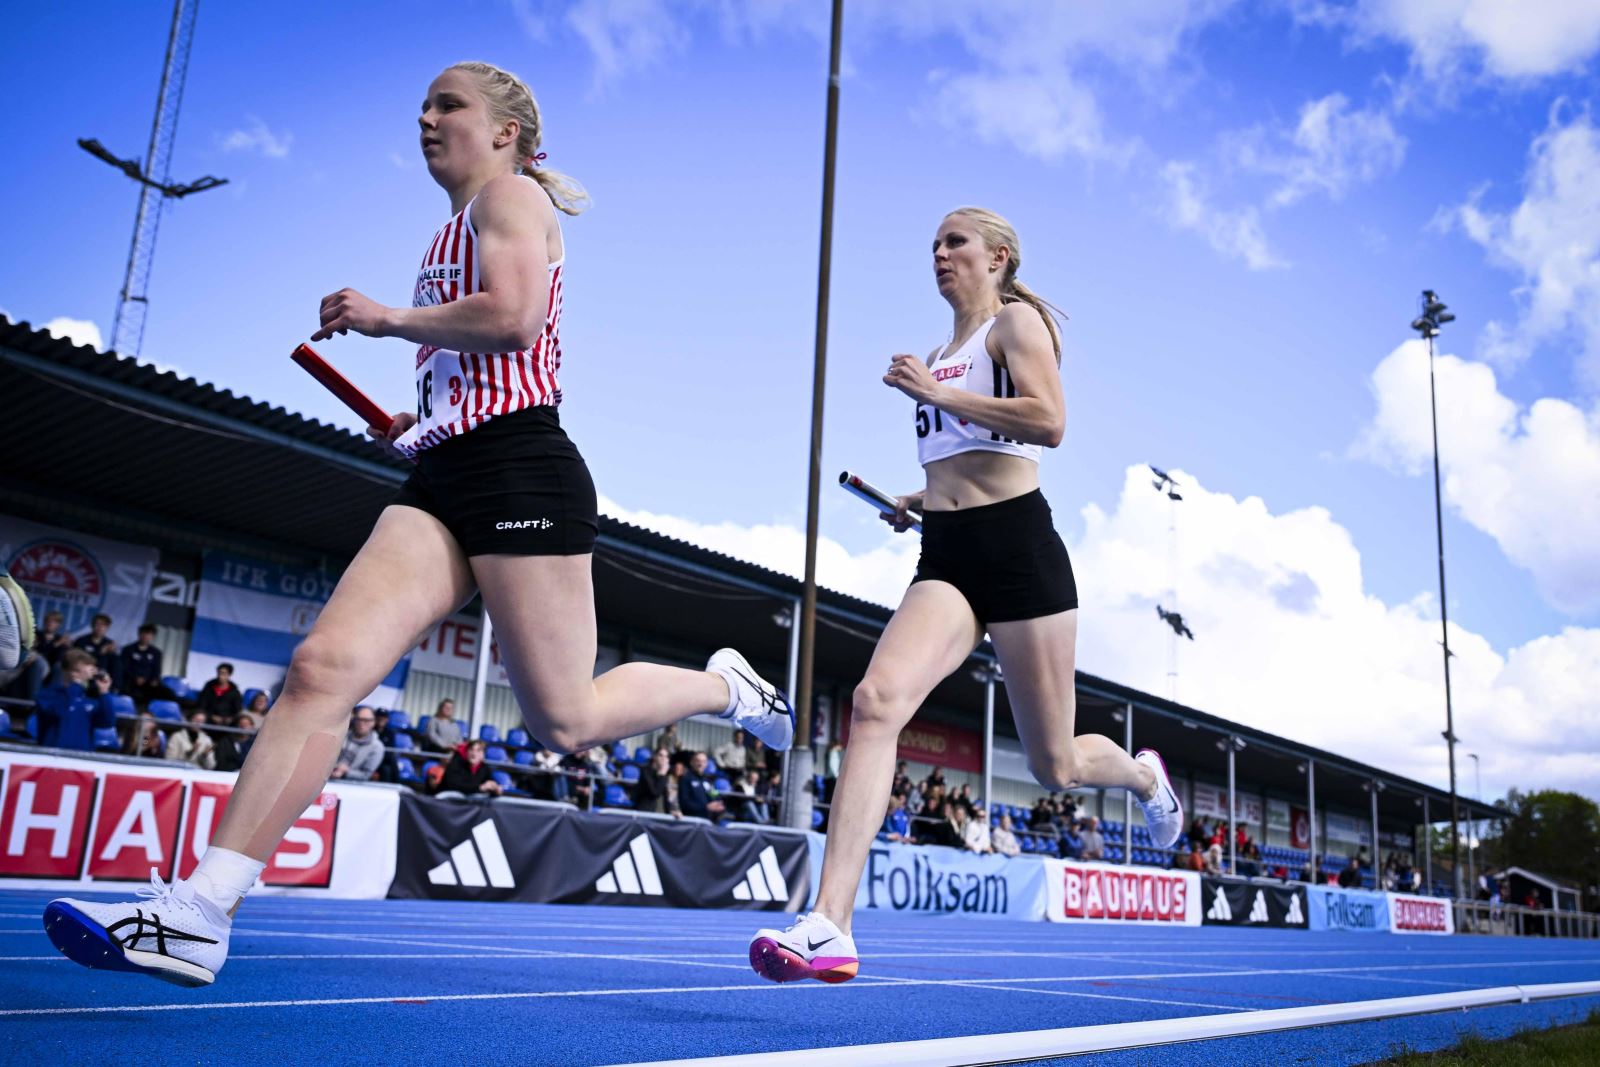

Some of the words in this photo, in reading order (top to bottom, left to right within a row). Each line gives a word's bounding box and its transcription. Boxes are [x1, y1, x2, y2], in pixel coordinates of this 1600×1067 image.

[449, 269, 461, 279] IF
[448, 375, 462, 407] 3
[495, 520, 541, 530] CRAFT
[221, 560, 268, 591] IFK
[866, 848, 1008, 915] Folksam
[1065, 870, 1186, 916] BAUHAUS
